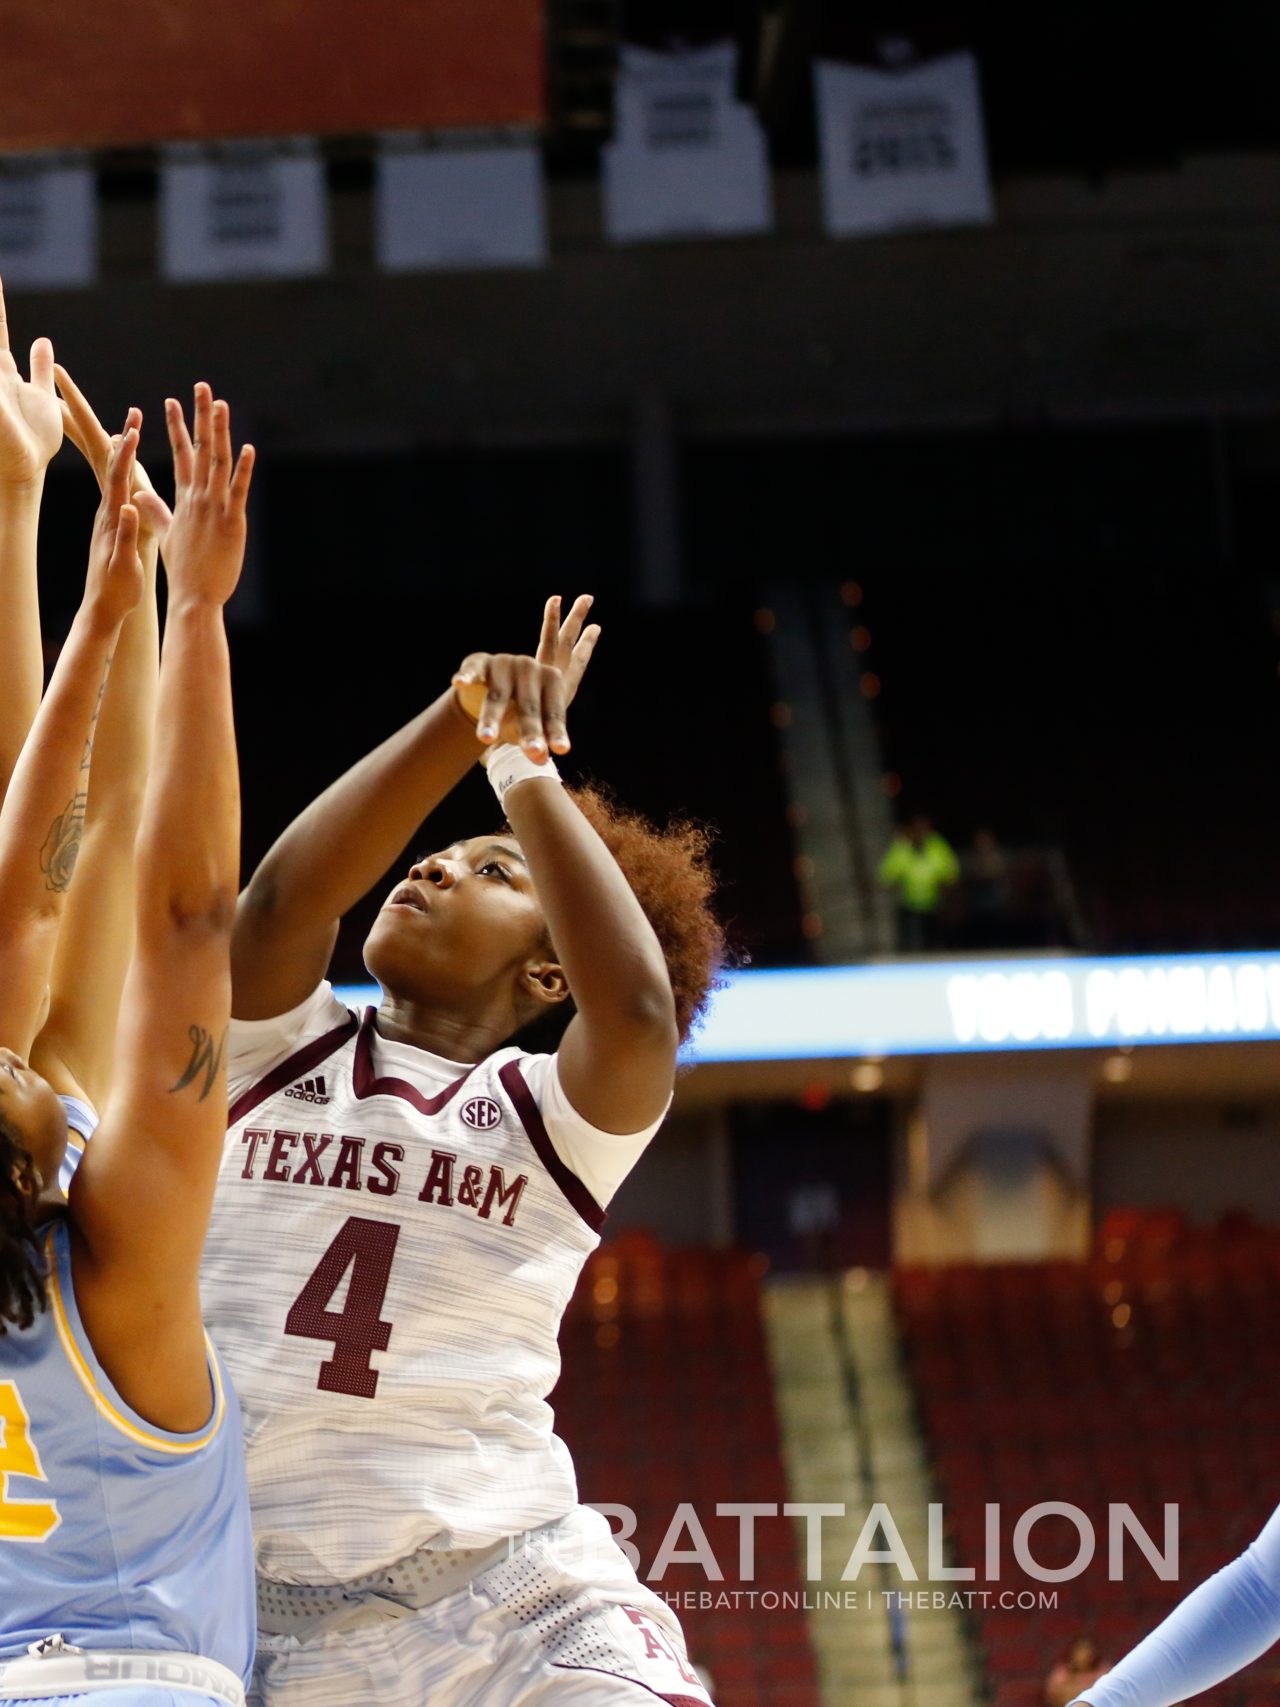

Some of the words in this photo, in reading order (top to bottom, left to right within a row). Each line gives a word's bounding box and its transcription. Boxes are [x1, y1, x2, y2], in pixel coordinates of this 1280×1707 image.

[284, 1088, 331, 1105] adidas
[465, 1099, 499, 1127] SEC
[241, 1129, 406, 1198] TEXAS
[417, 1149, 530, 1228] A&M
[284, 1214, 402, 1400] 4
[84, 1657, 241, 1704] RMOUR
